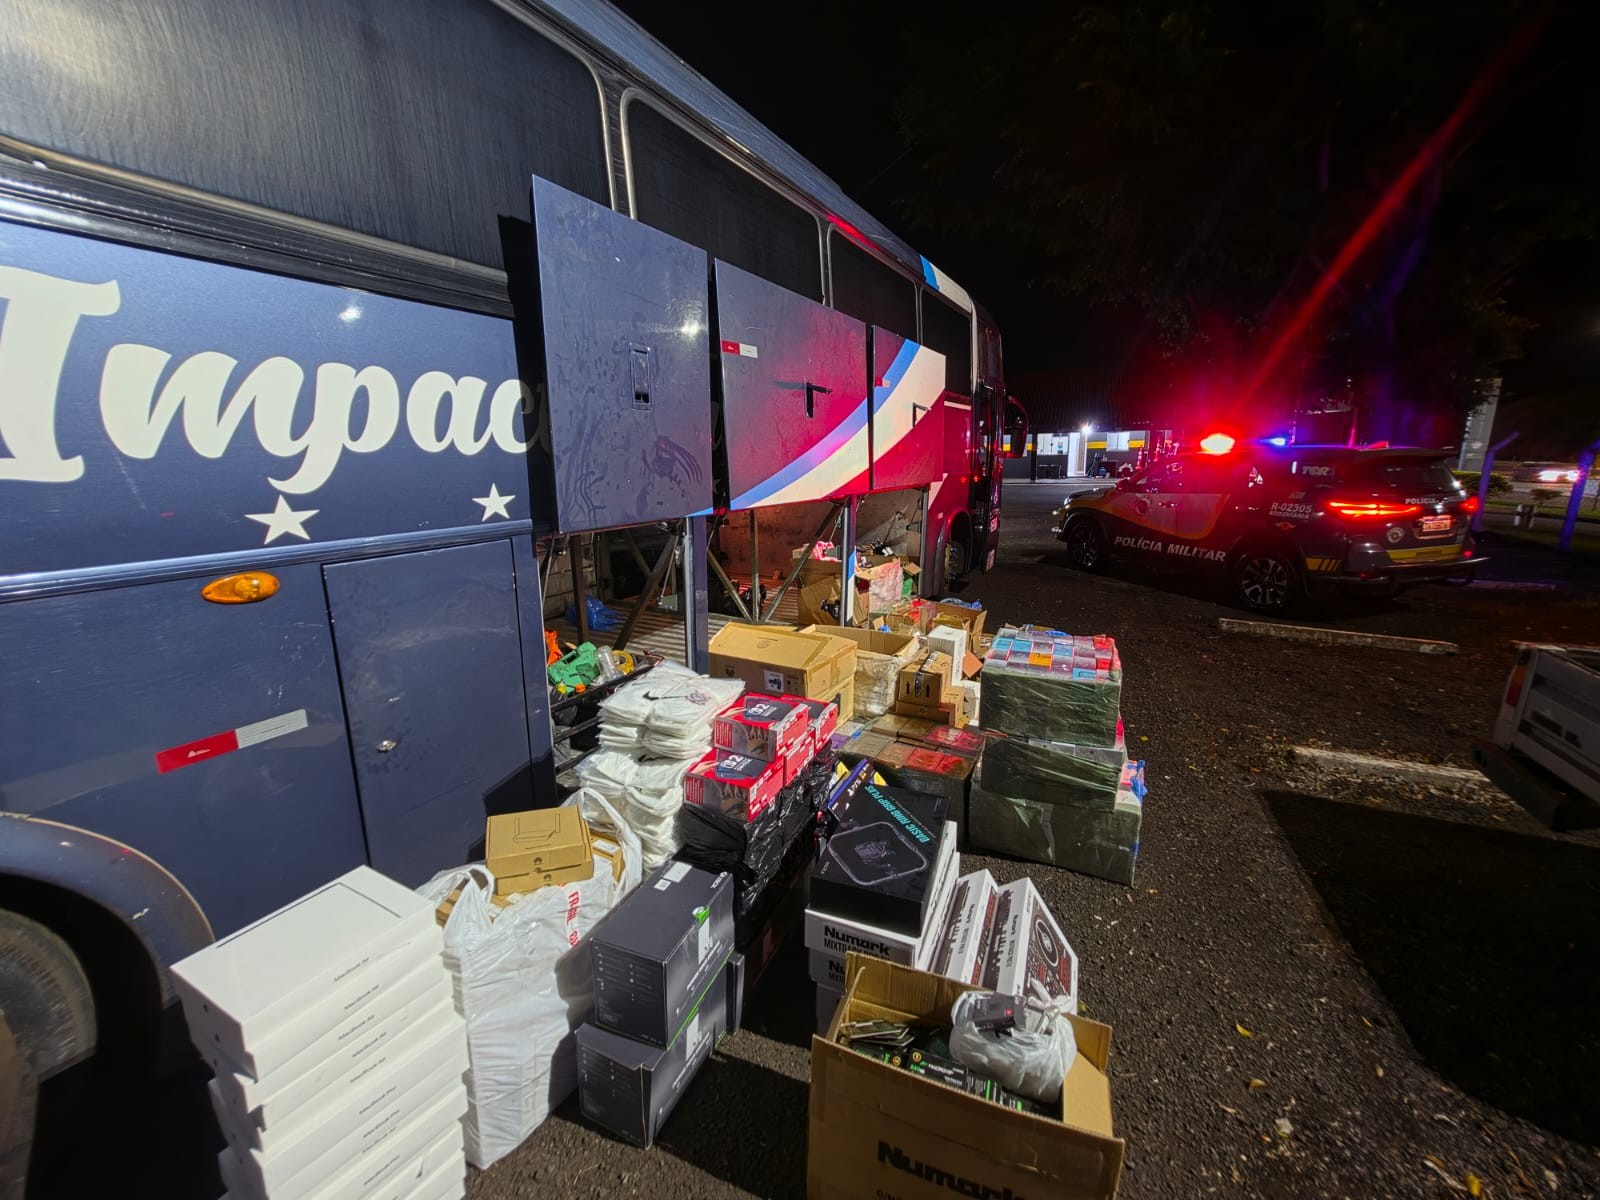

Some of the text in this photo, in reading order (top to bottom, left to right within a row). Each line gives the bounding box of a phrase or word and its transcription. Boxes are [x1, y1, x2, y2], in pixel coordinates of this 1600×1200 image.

[0, 265, 551, 495] Impac
[1113, 535, 1227, 562] POLÍCIA MILITAR
[823, 925, 890, 956] Numark
